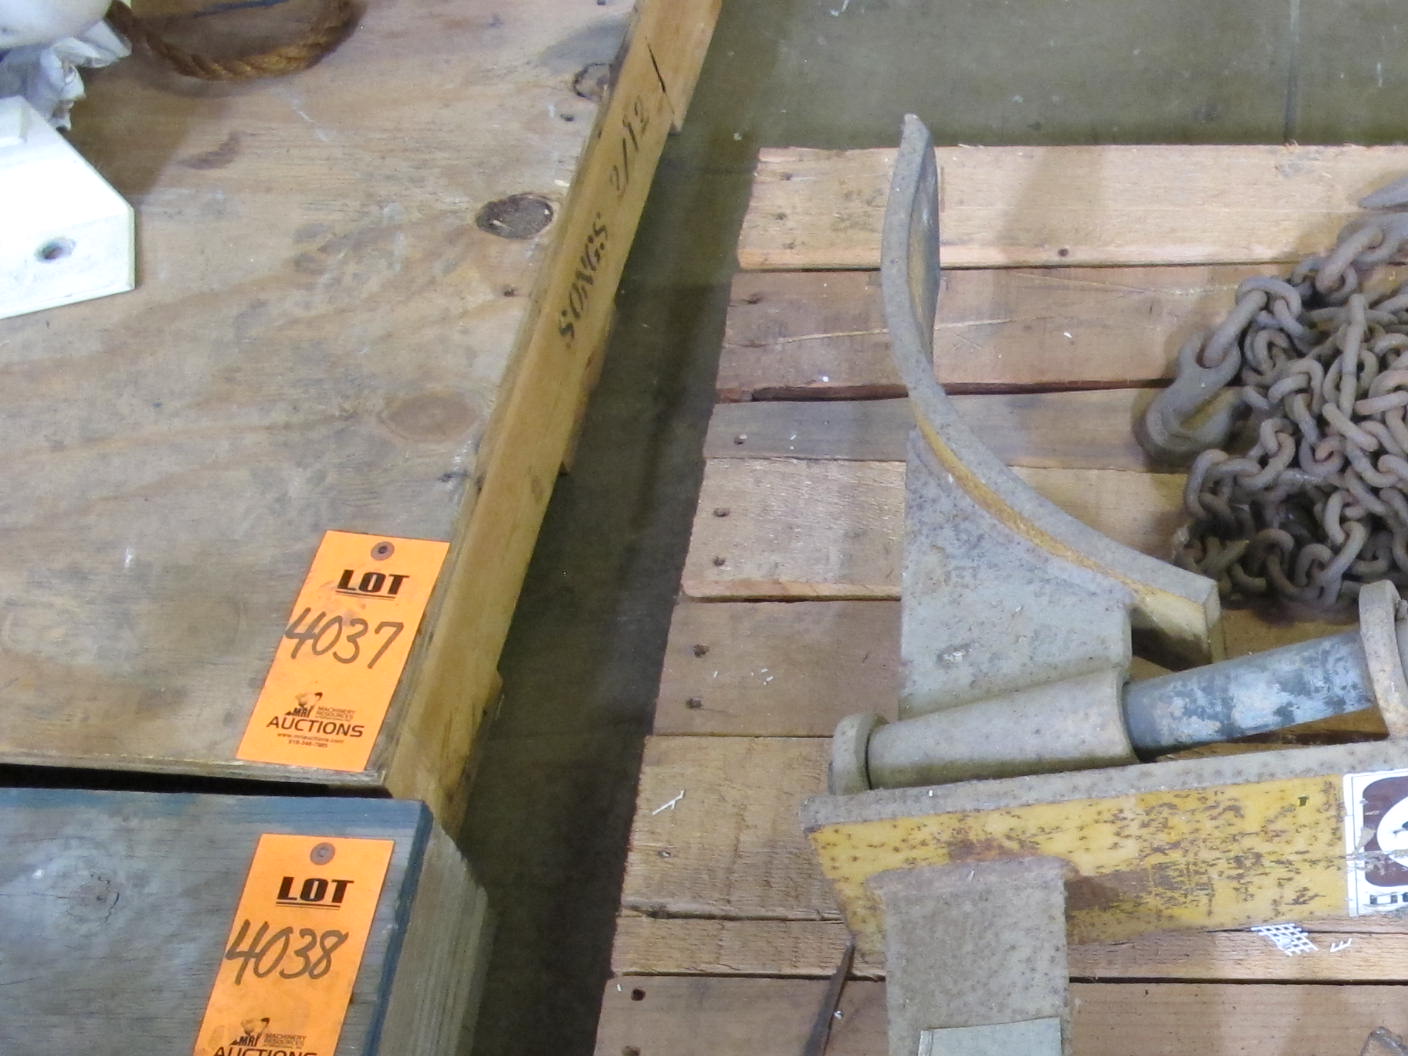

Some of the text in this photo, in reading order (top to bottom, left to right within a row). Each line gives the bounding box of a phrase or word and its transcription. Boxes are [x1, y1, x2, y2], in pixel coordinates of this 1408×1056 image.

[337, 569, 410, 595] LOT
[285, 607, 404, 669] 4037
[266, 716, 365, 737] AUCTIONS
[277, 876, 355, 904] LOT
[224, 919, 350, 986] 4038
